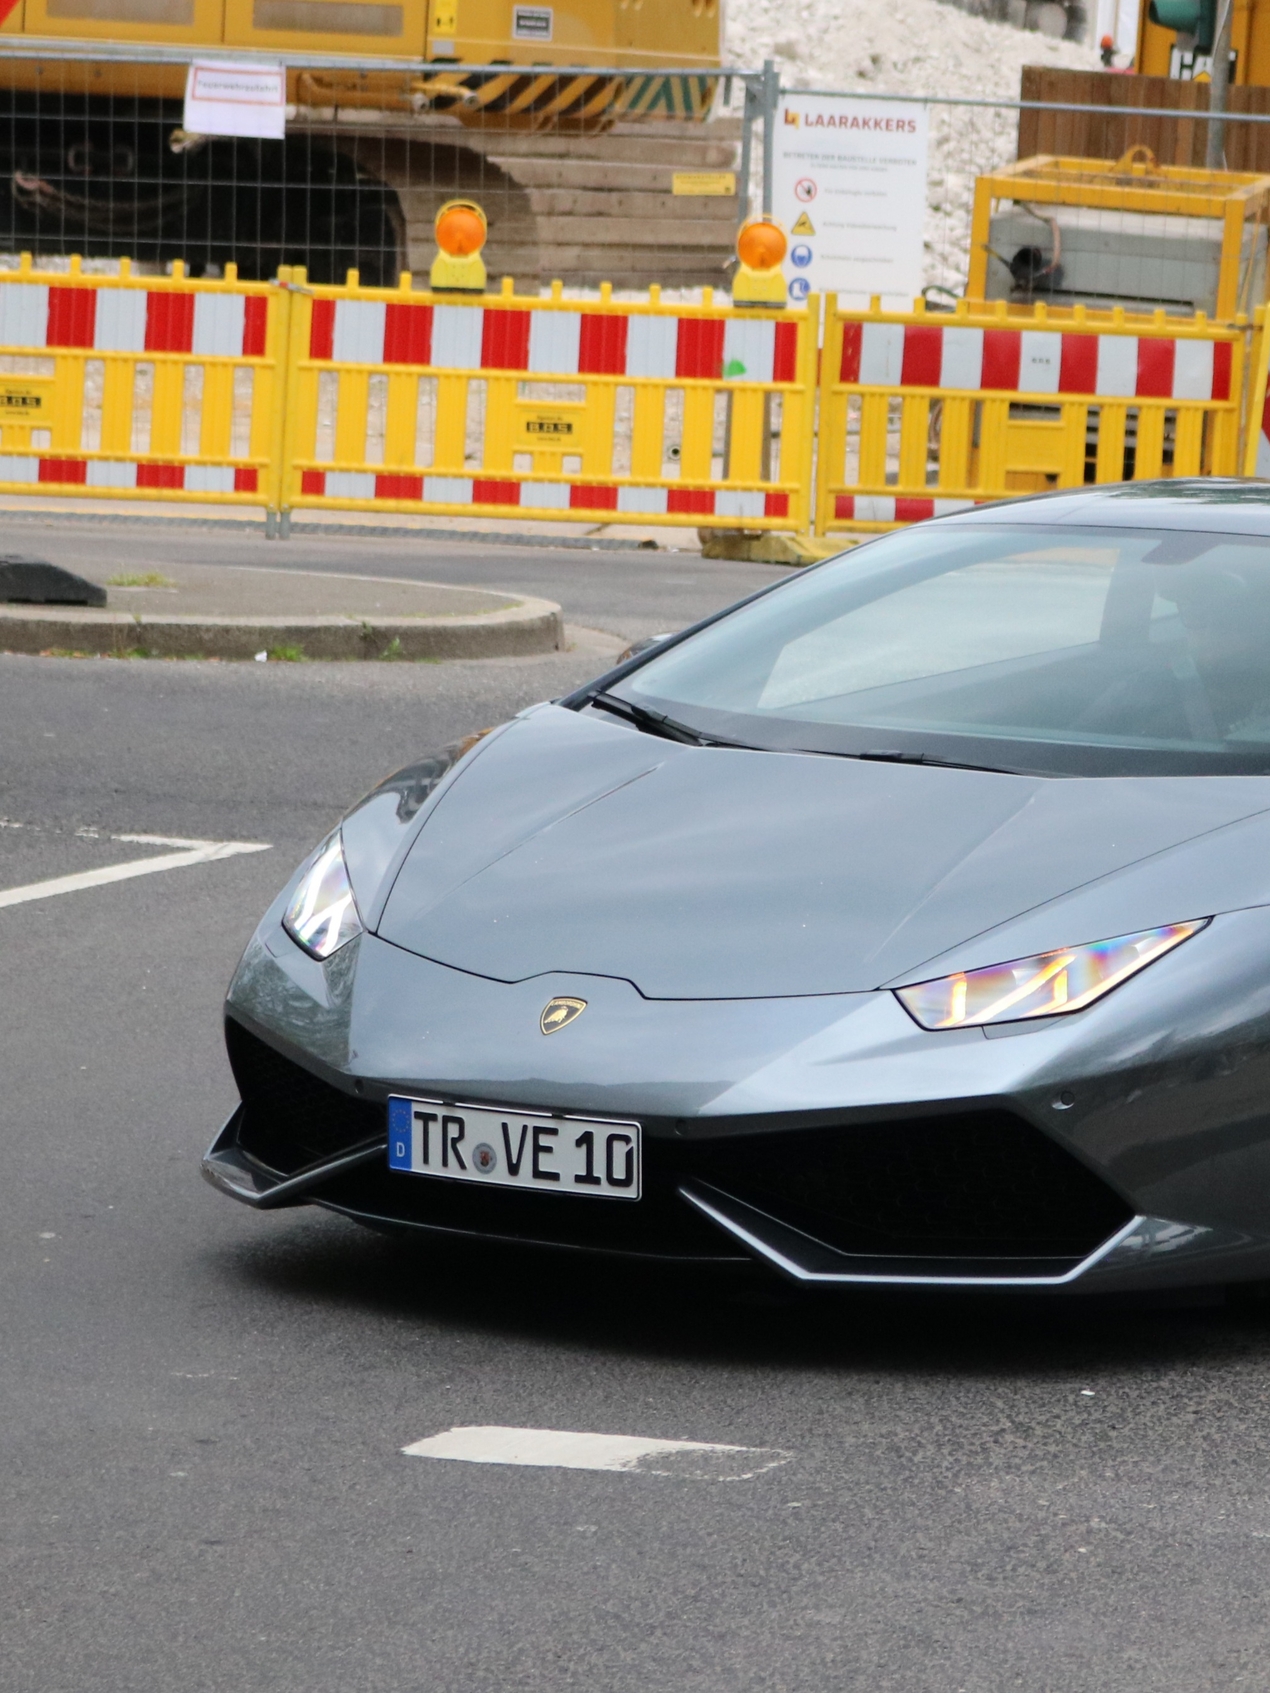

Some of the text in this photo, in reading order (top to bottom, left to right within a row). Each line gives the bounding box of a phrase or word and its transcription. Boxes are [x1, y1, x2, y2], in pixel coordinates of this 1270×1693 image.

[804, 113, 917, 133] LAARAKKERS
[783, 151, 819, 161] BETRETEN
[837, 155, 877, 164] BAUSTELLE
[879, 157, 918, 167] VERBOTEN
[396, 1141, 406, 1158] D
[413, 1110, 635, 1188] TR VE 10
